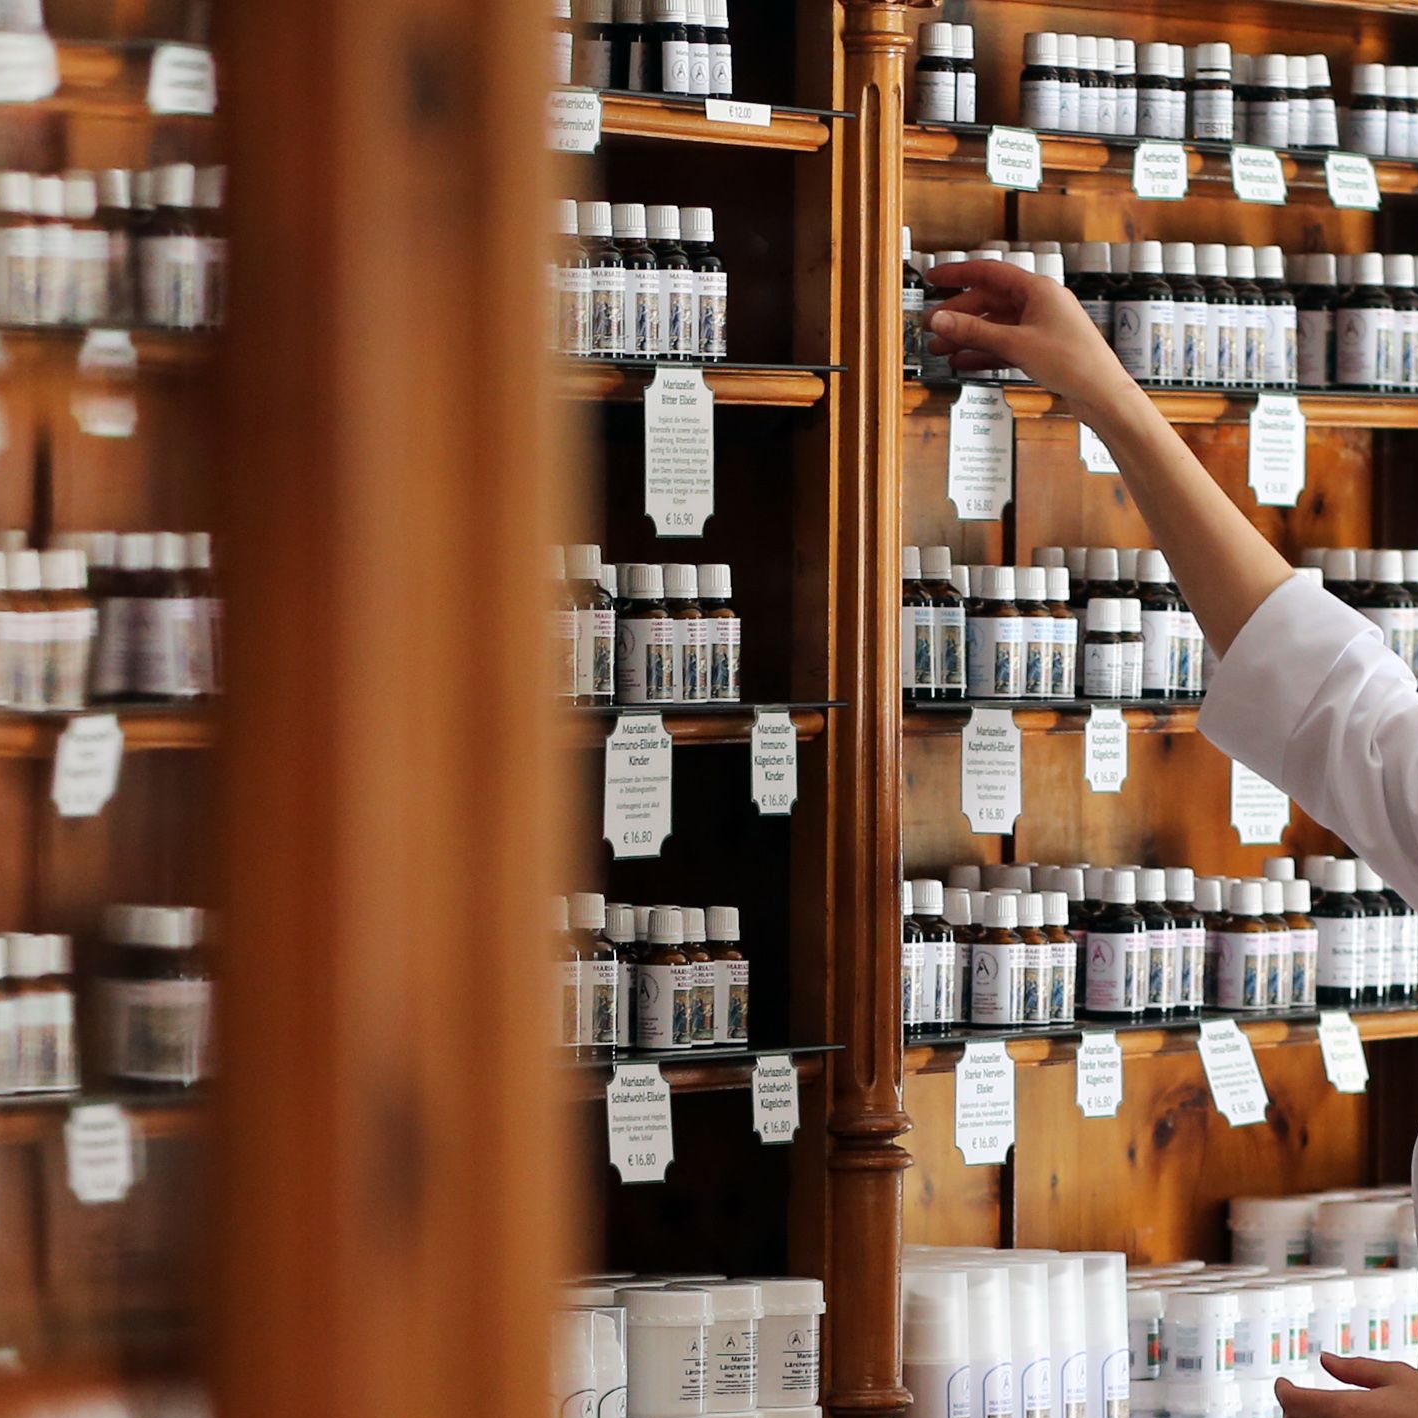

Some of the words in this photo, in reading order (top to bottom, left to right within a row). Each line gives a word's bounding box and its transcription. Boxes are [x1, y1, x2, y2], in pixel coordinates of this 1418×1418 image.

[665, 513, 671, 525] €
[622, 723, 657, 734] Mariazeller
[757, 723, 791, 734] Mariazeller
[976, 726, 1008, 737] Mariazeller
[611, 738, 659, 751] Immuno-Elixier
[661, 738, 670, 748] für
[760, 740, 788, 749] Immuno-
[628, 755, 650, 766] Kinder
[754, 755, 784, 768] Kügelchen
[785, 754, 794, 765] für
[765, 770, 785, 781] Kinder
[623, 832, 629, 844] €
[969, 1053, 1001, 1064] Mariazeller
[758, 1067, 792, 1078] Mariazeller
[621, 1076, 655, 1087] Mariazeller
[758, 1082, 793, 1094] Schlafwohl-
[611, 1092, 666, 1104] Schlafwohl-Elixier
[760, 1098, 792, 1112] Kügelchen
[627, 1154, 633, 1166] €
